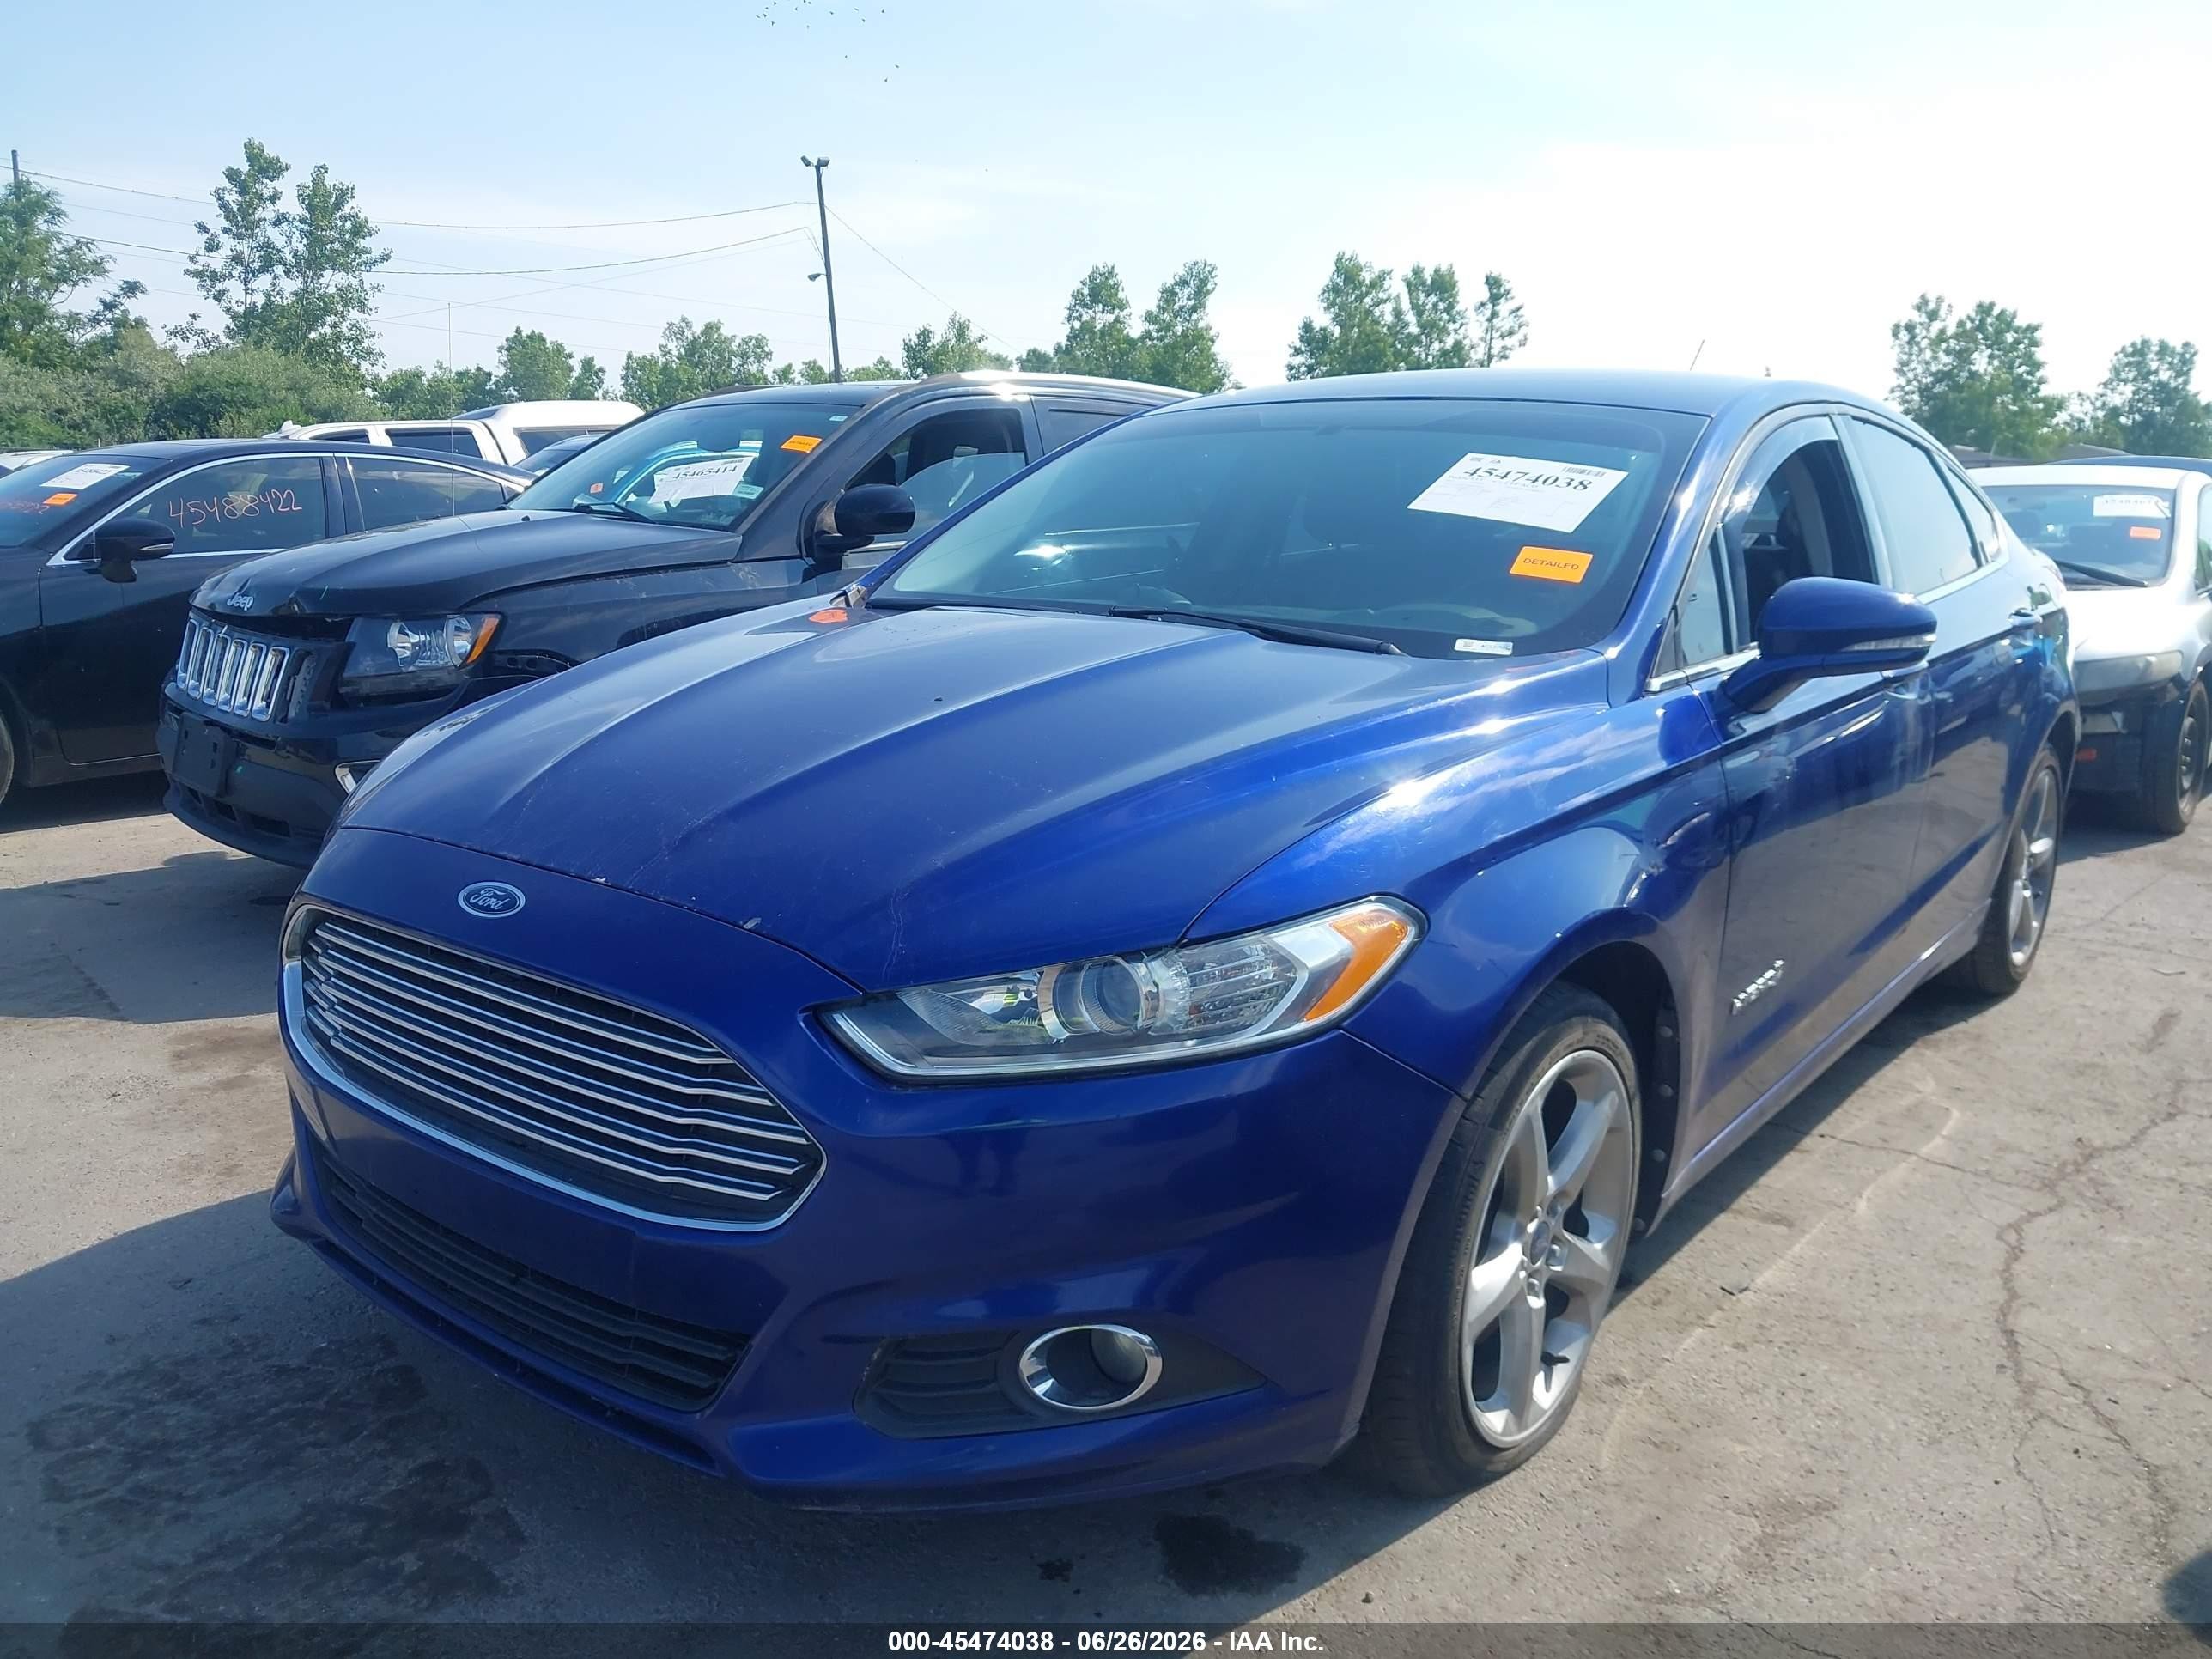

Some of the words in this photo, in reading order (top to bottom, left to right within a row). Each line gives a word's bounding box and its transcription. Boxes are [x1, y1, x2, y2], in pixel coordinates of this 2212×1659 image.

[673, 465, 738, 480] 45465414
[1463, 466, 1593, 491] 45474038
[168, 489, 303, 529] 45488422
[1522, 557, 1580, 571] DETAILED
[226, 592, 254, 611] Jeep
[469, 887, 512, 911] Ford
